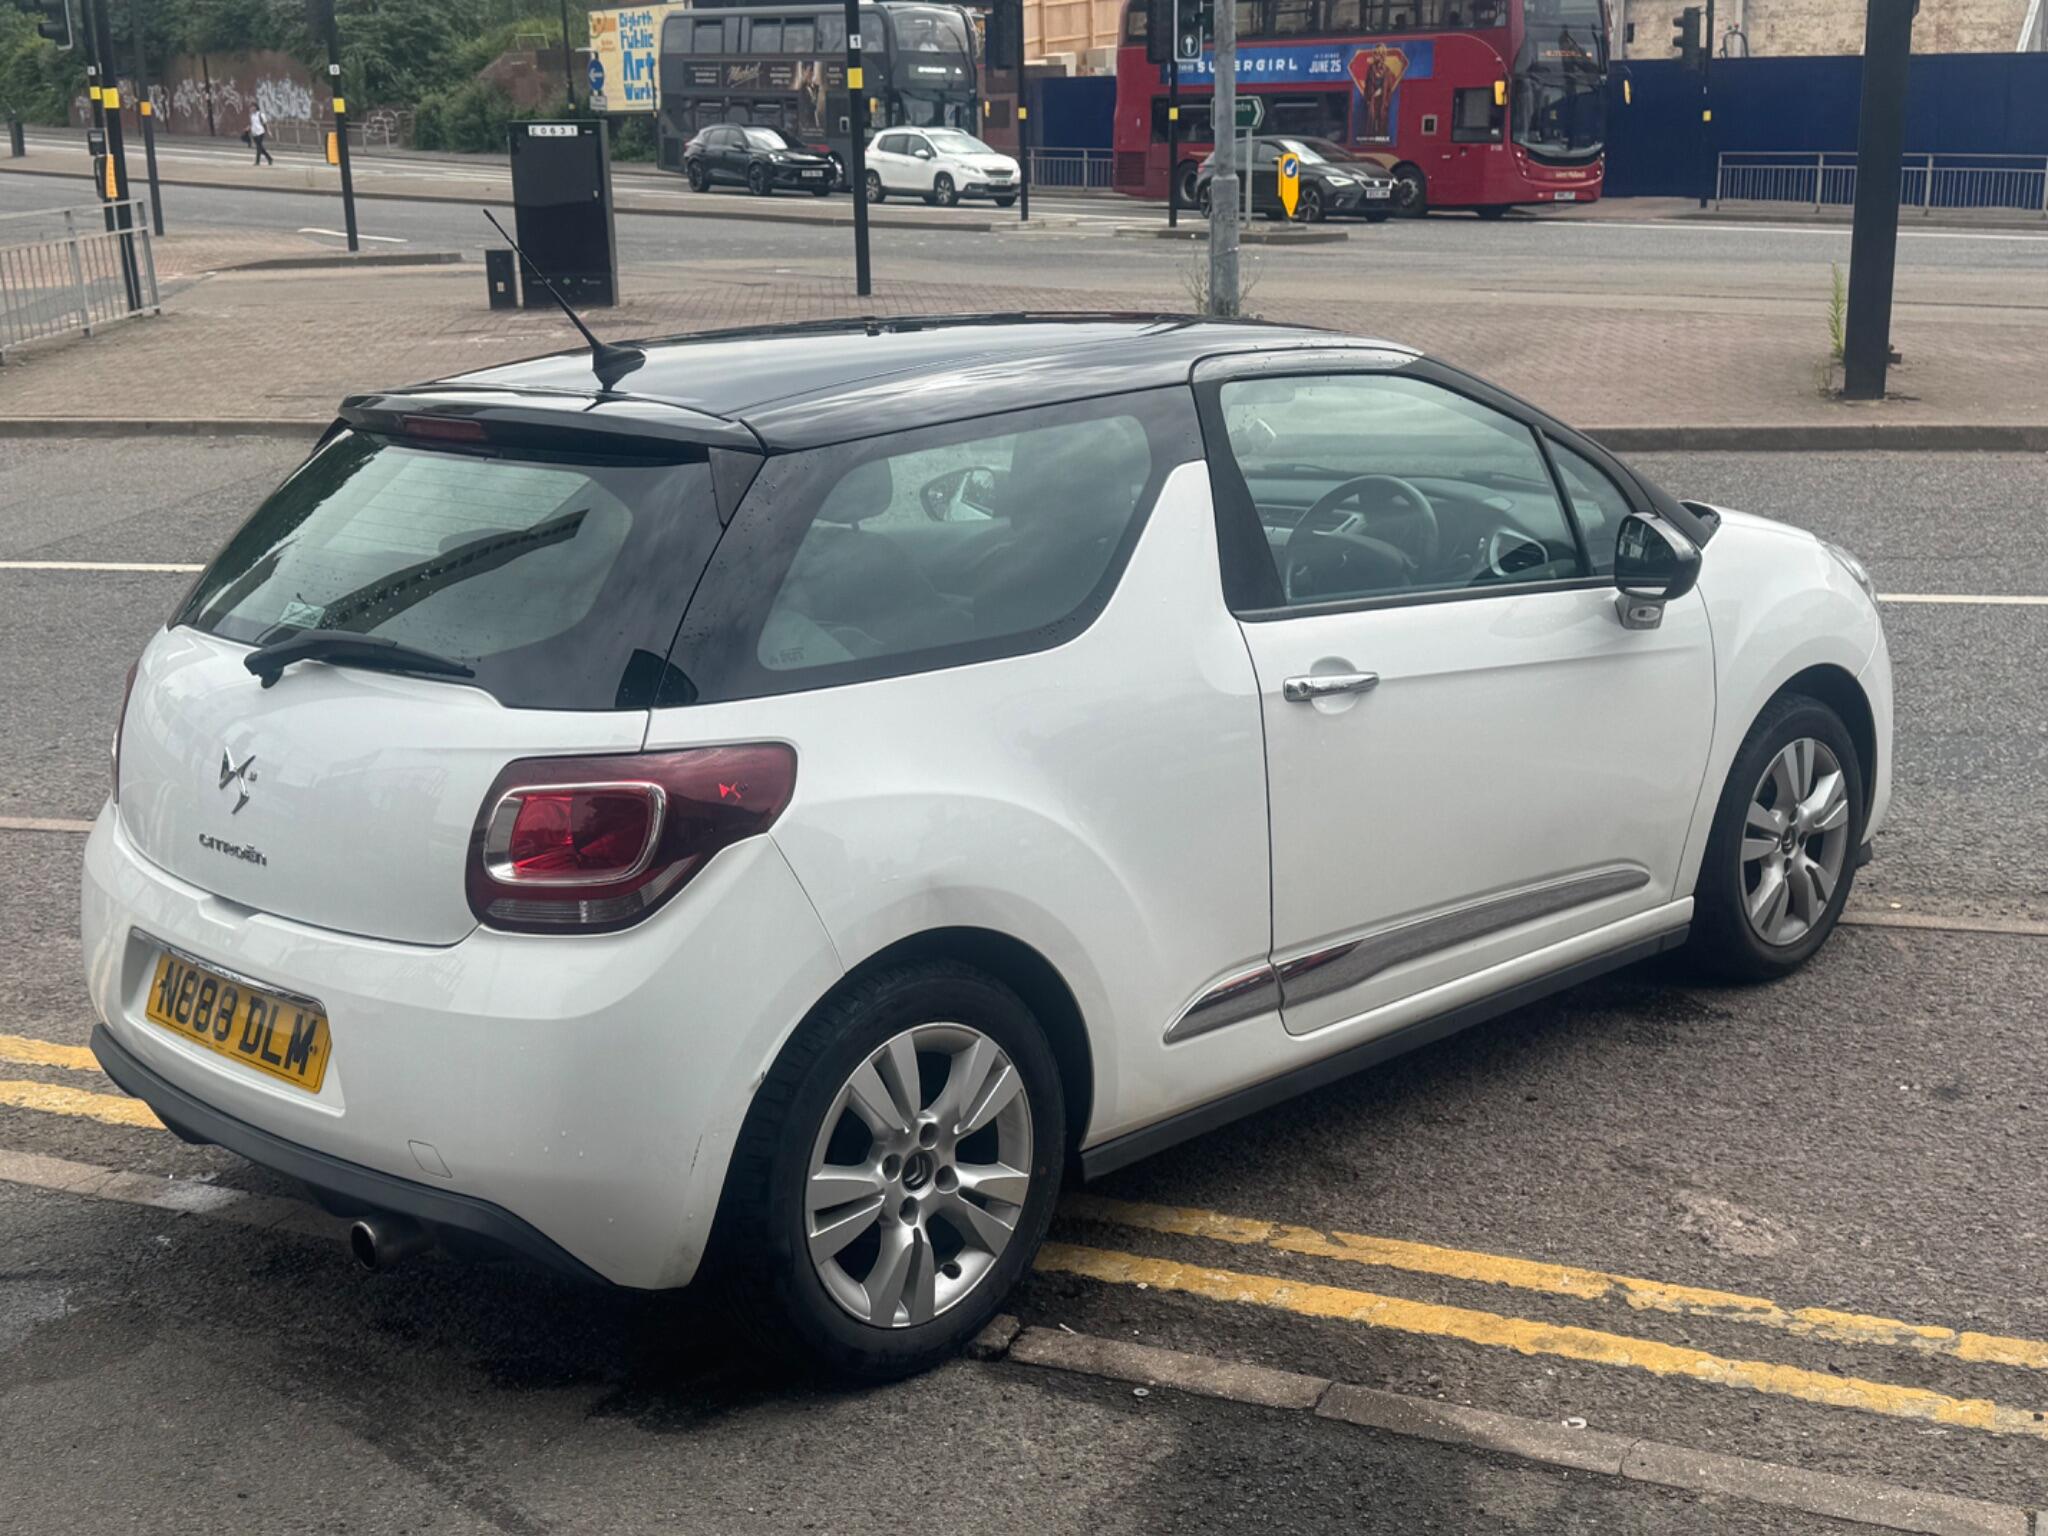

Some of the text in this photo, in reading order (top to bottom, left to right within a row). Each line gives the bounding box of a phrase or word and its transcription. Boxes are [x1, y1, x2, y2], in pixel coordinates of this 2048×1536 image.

[620, 29, 654, 49] Public
[623, 51, 655, 80] Art
[1197, 58, 1298, 74] SUERGIRL
[1309, 59, 1341, 74] JUNE 25
[156, 961, 318, 1077] N888 DLM
